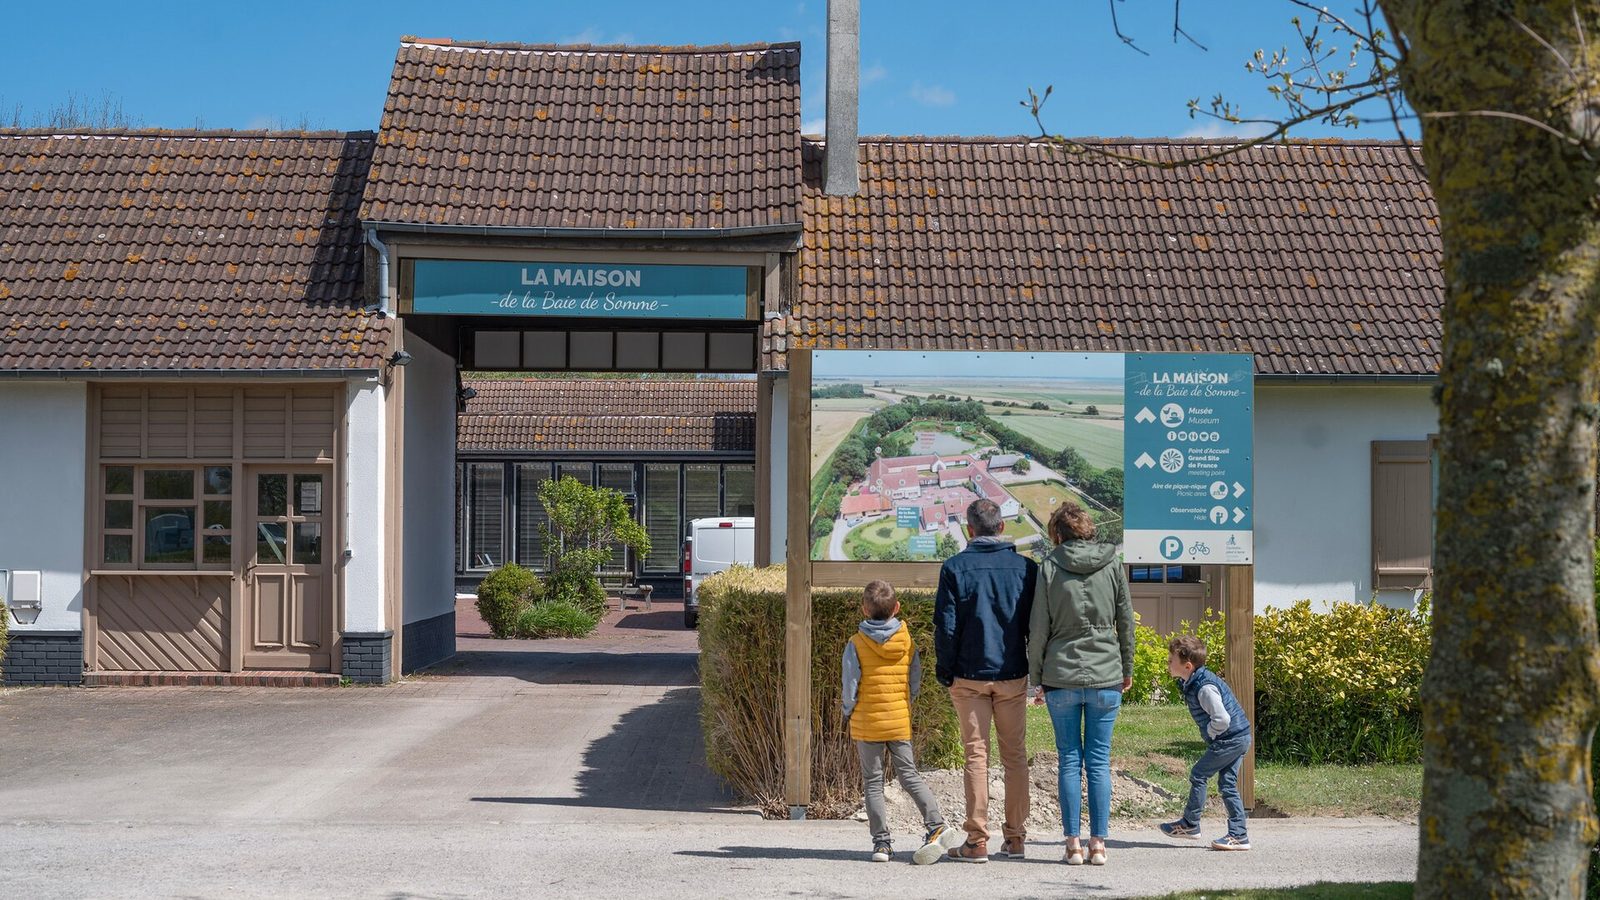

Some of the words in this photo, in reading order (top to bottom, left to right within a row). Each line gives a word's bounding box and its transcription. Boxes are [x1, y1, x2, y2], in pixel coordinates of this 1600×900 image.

[521, 268, 548, 286] LA
[553, 269, 641, 287] MAISON
[521, 290, 537, 309] la
[541, 290, 577, 310] Baie
[580, 291, 598, 310] de
[1153, 372, 1170, 384] LA
[1173, 372, 1228, 384] MAISON
[1153, 384, 1162, 396] la
[1166, 384, 1189, 397] Baie
[1190, 384, 1202, 397] de
[1188, 406, 1213, 415] Musée
[1188, 416, 1220, 425] Museum
[1165, 538, 1180, 557] P
